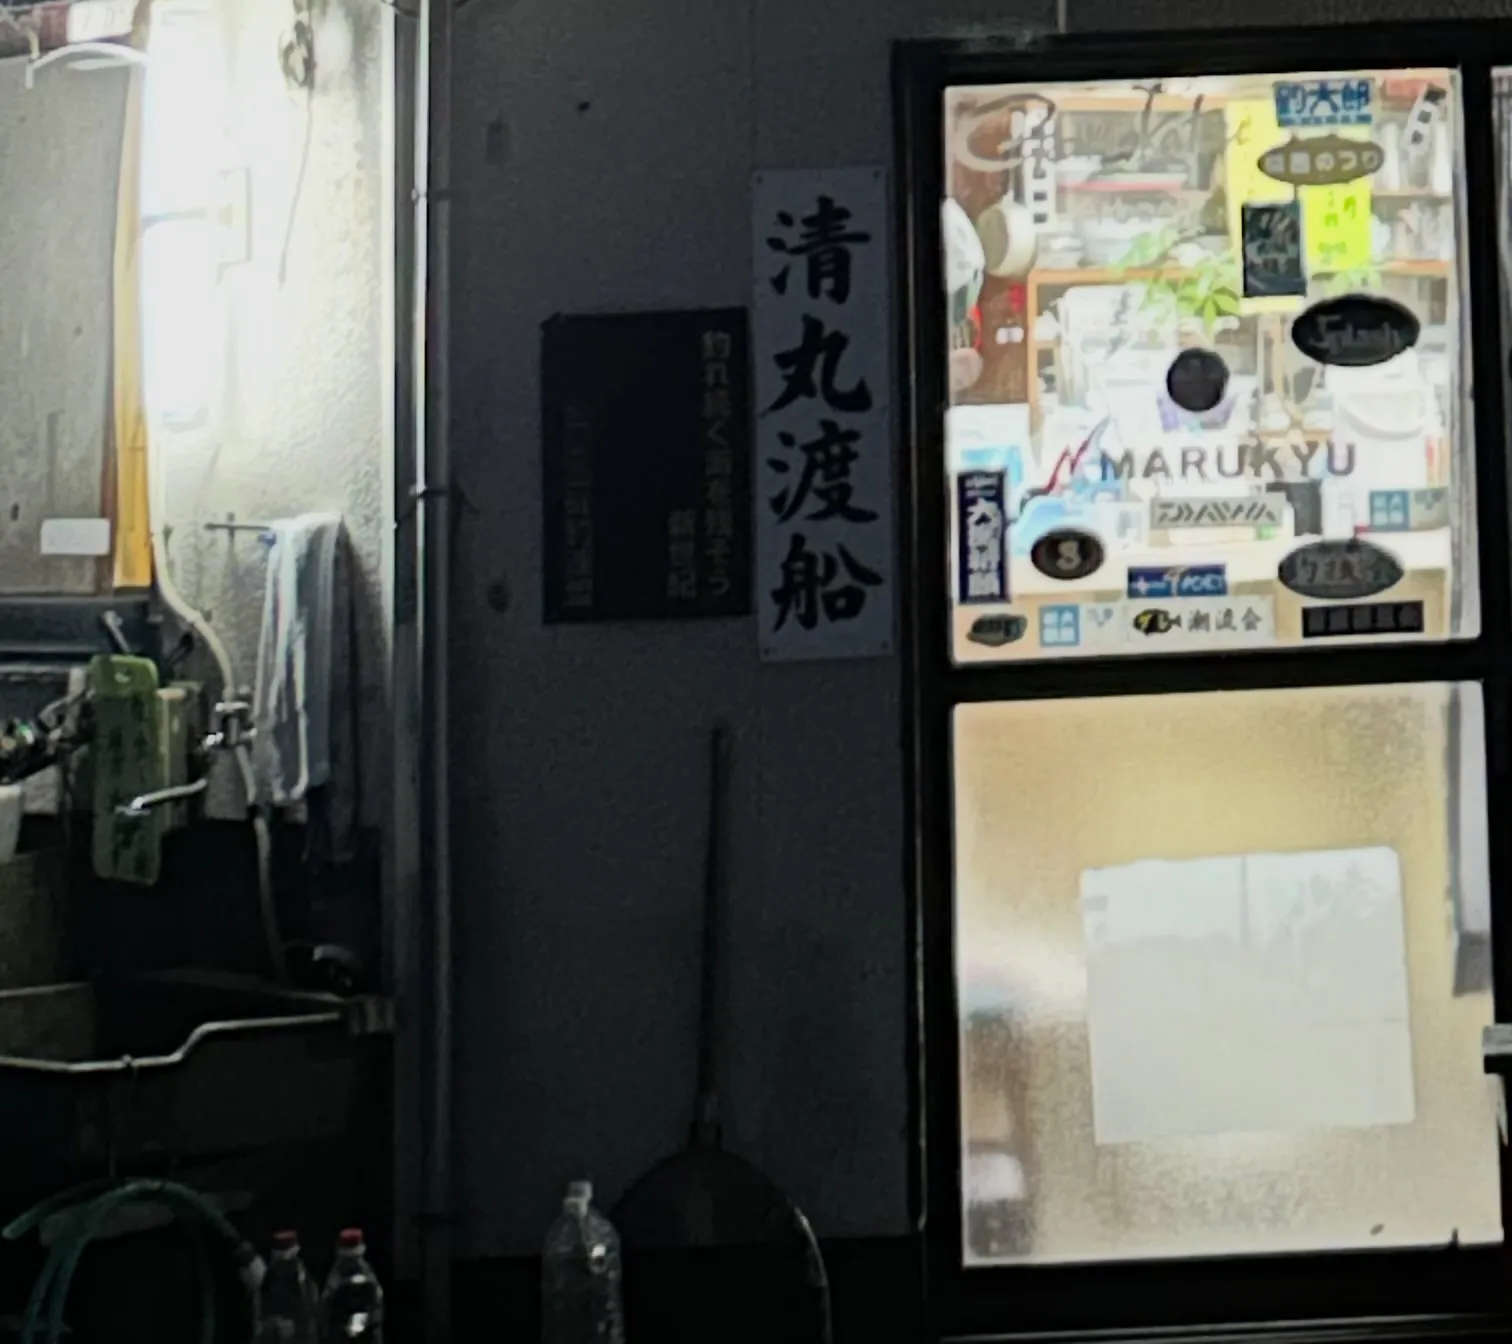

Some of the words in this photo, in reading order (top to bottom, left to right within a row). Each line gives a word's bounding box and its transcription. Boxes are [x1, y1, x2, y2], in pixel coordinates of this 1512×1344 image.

[761, 195, 884, 633] 清丸渡船
[1100, 442, 1356, 481] MARUKYU
[1157, 501, 1277, 523] DAIWA
